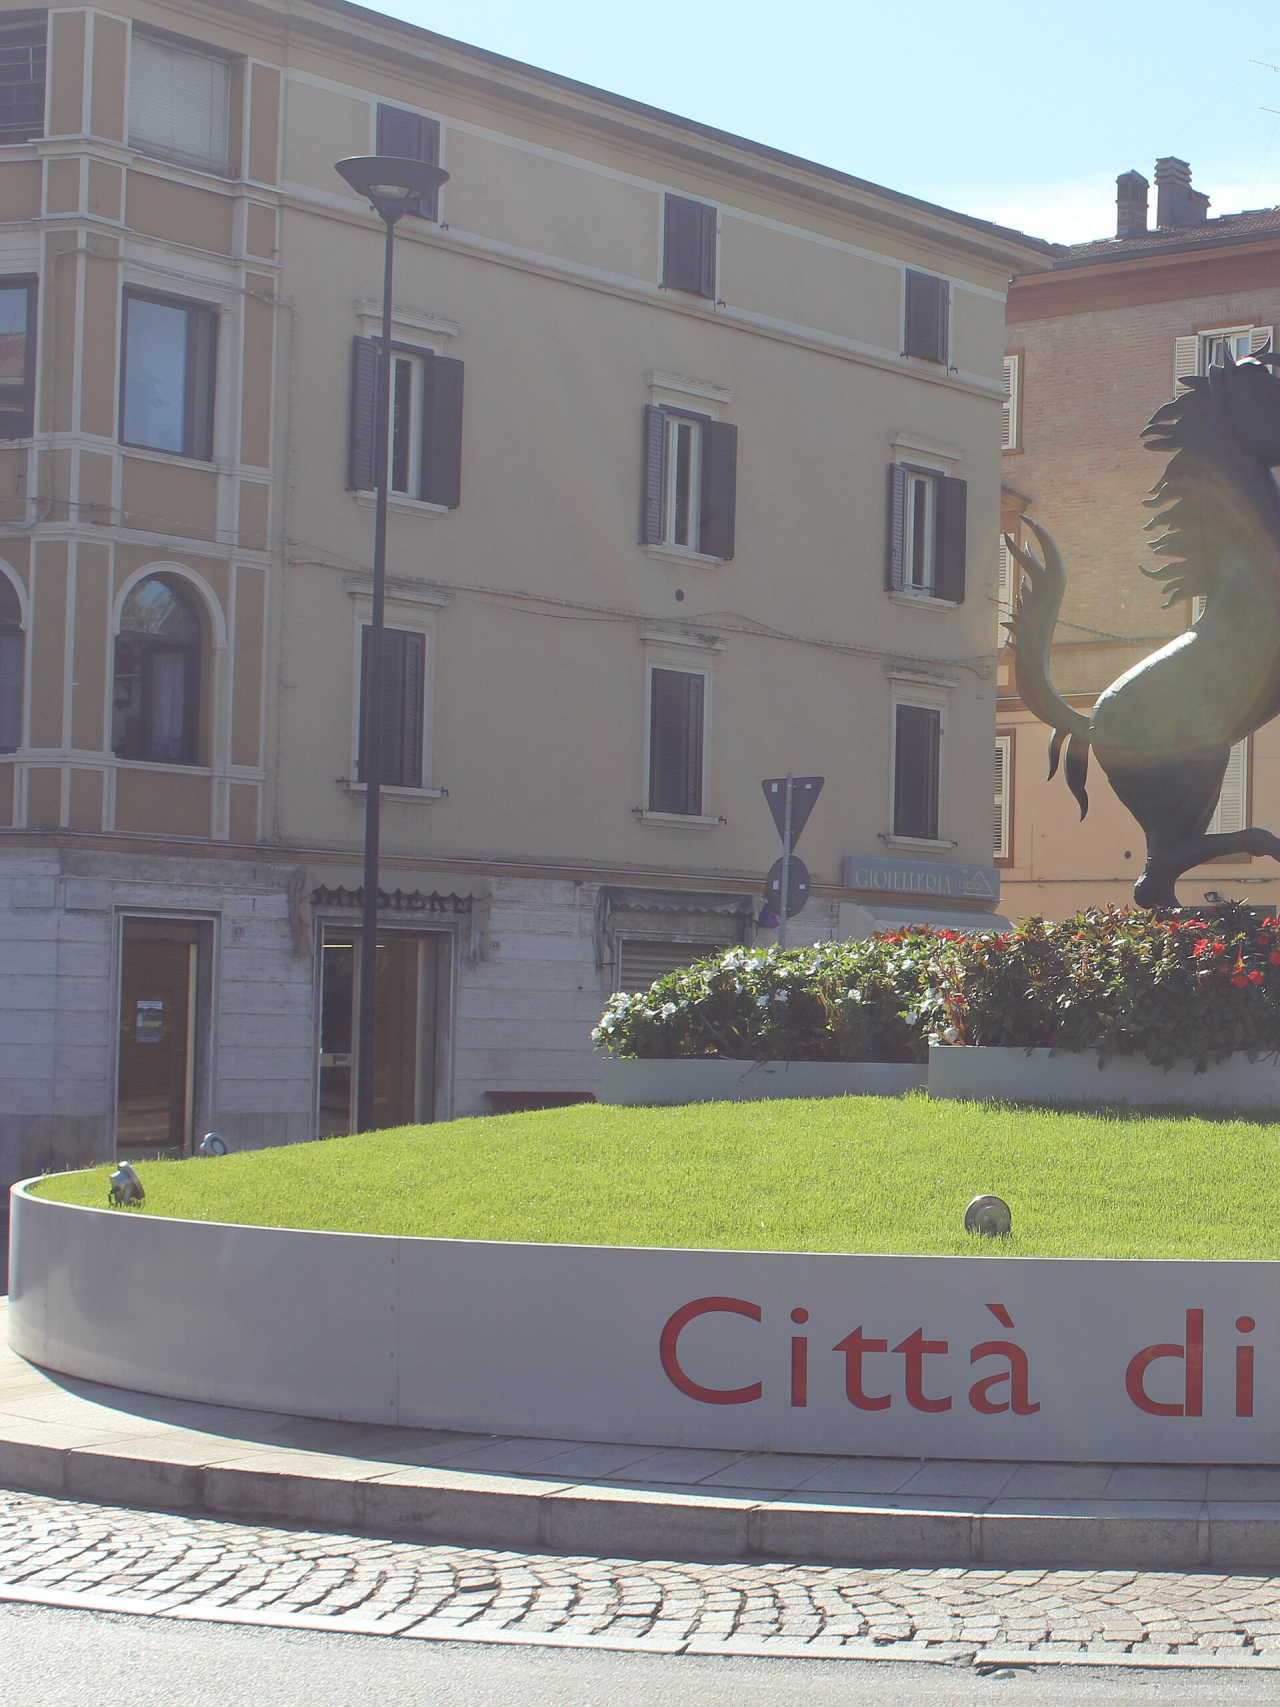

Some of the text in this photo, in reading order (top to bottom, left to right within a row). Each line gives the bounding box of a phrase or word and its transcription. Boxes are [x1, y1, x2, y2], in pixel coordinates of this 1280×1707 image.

[855, 868, 952, 894] GIOIELLERIA
[659, 1295, 1041, 1416] Città
[1125, 1308, 1255, 1418] di
